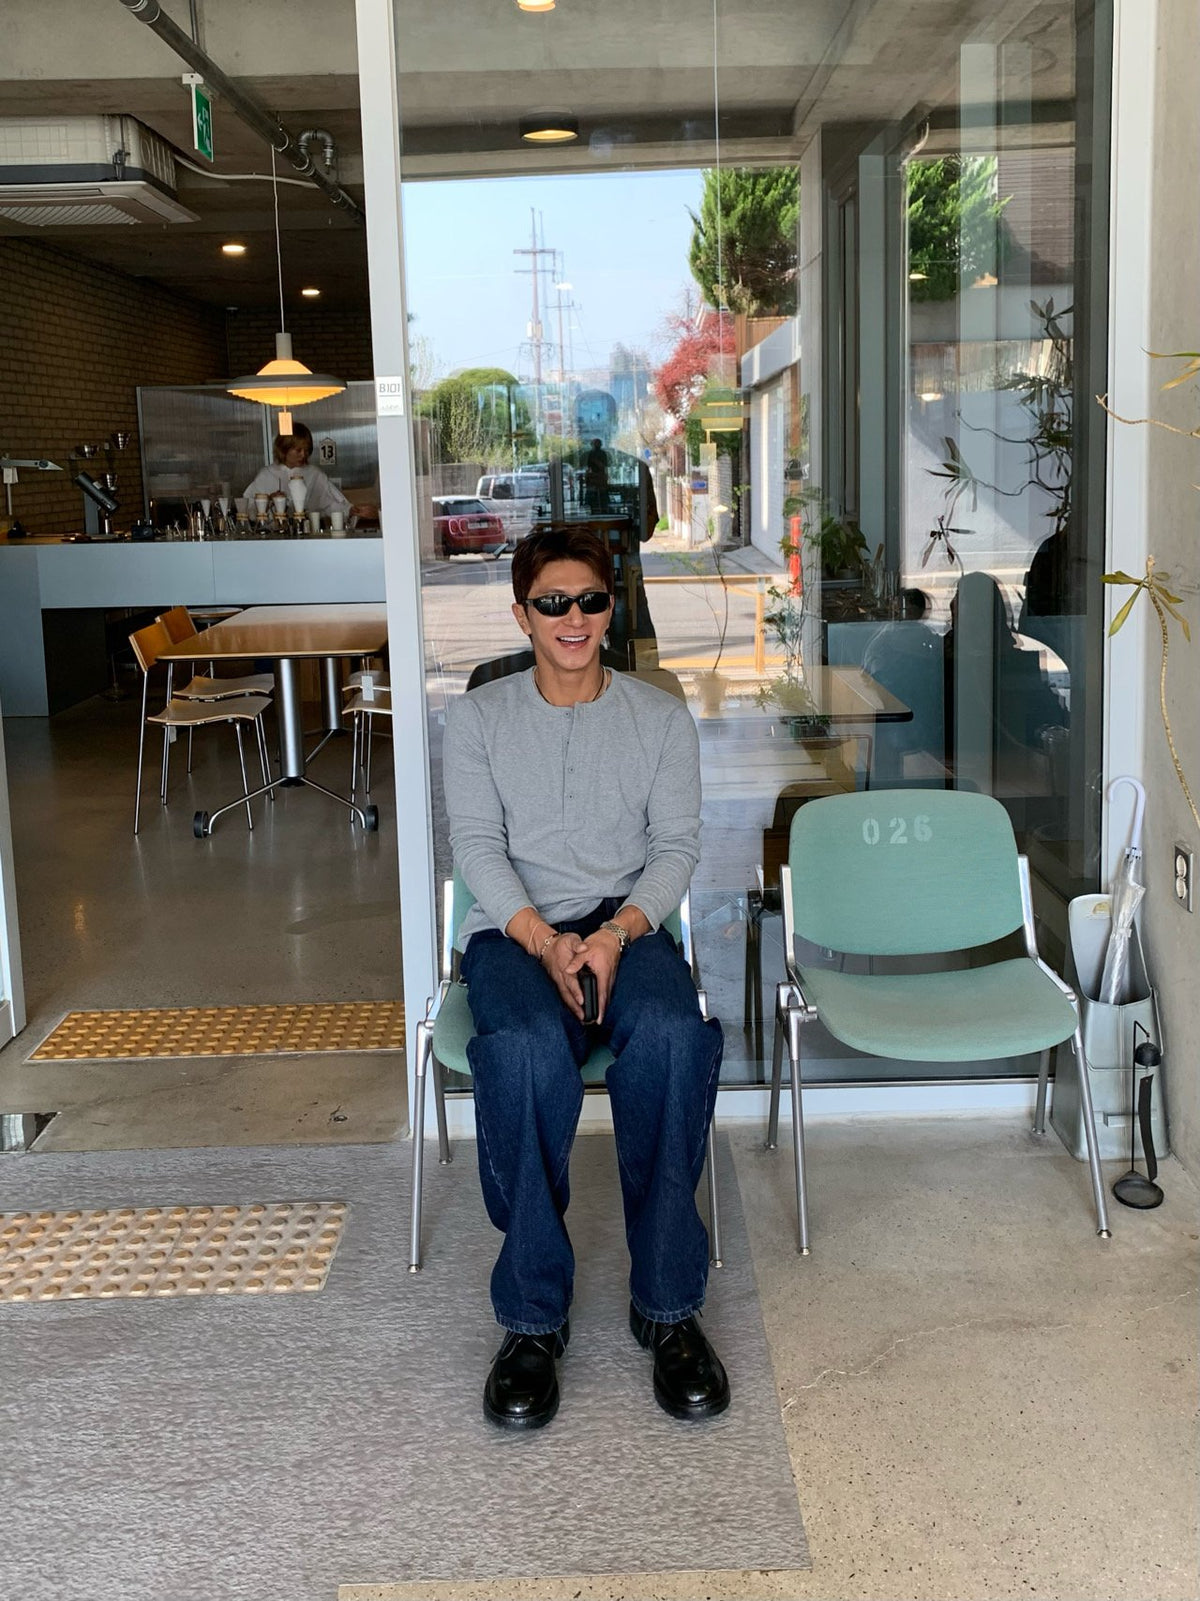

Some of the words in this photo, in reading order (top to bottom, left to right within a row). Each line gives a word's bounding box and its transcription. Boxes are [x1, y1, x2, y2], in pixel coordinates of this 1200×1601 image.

[379, 383, 400, 393] B101
[321, 445, 334, 459] 13
[862, 814, 933, 845] 026
